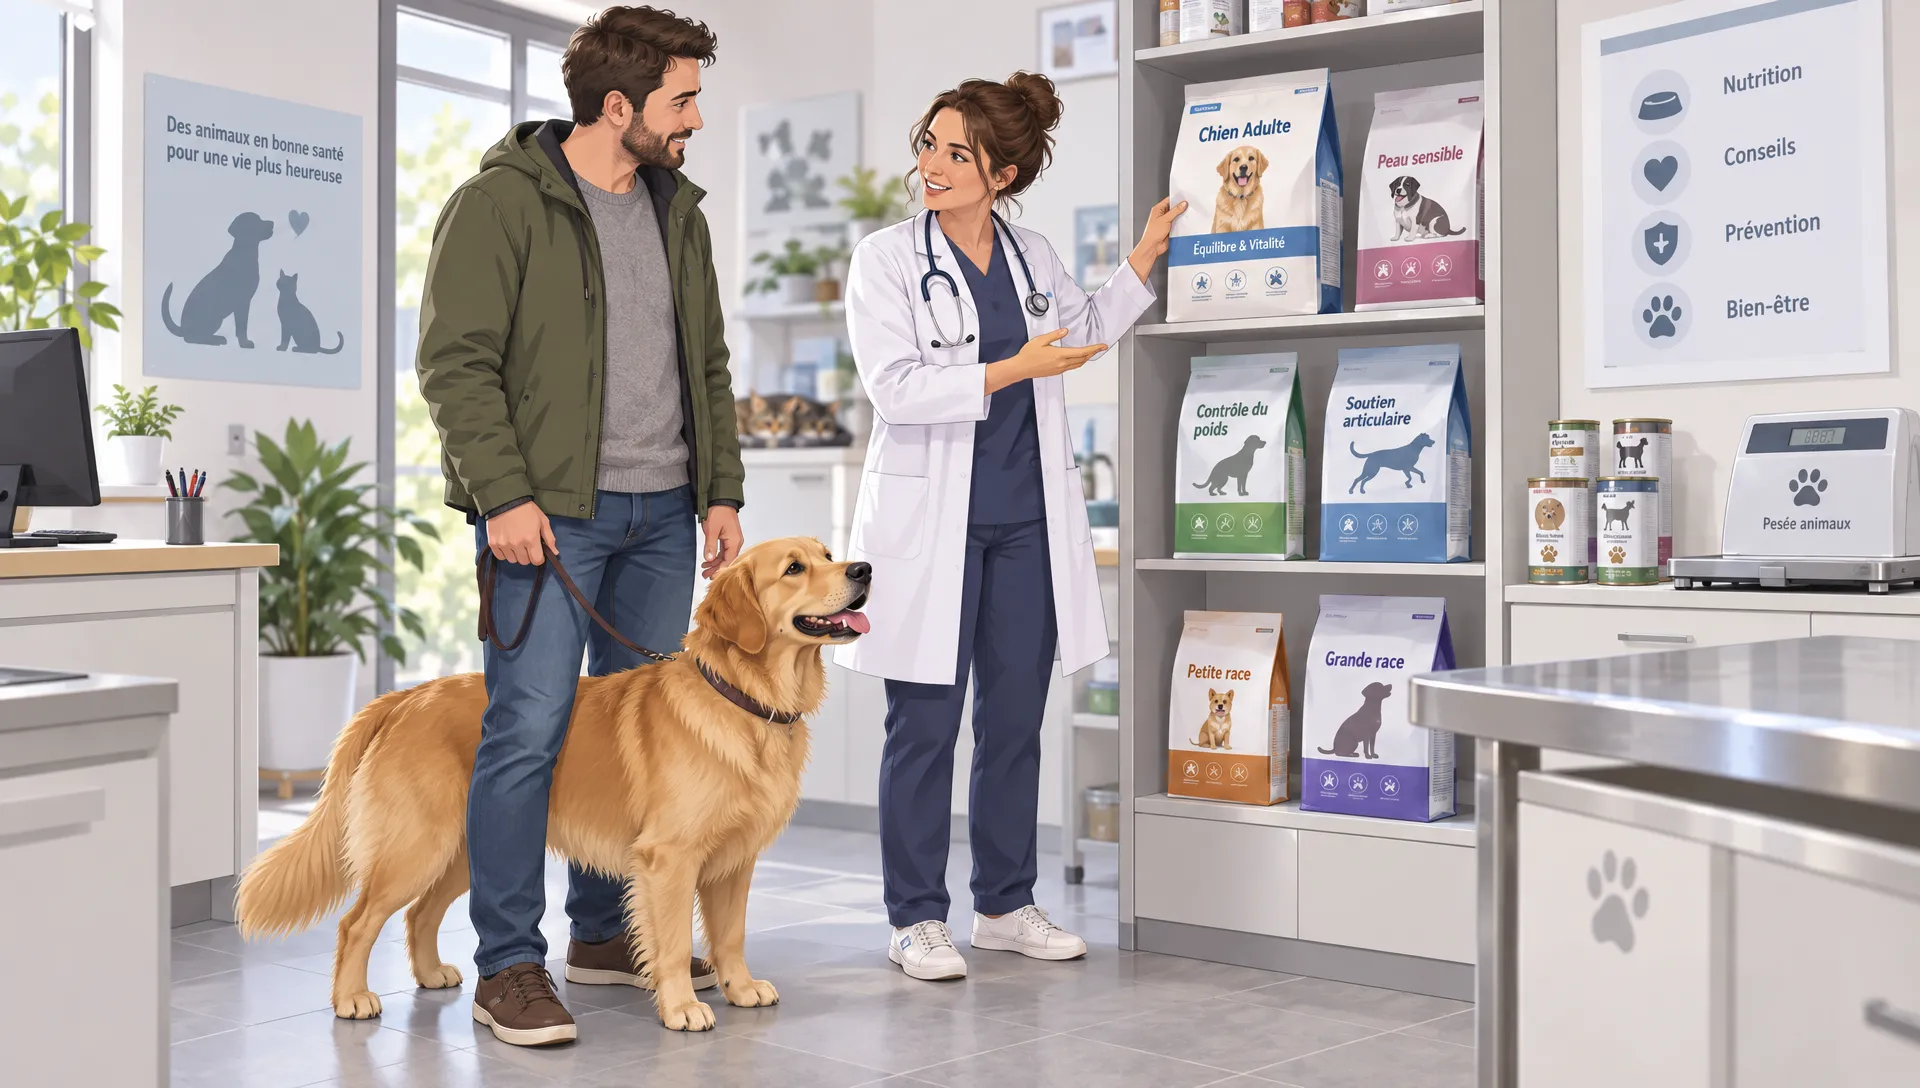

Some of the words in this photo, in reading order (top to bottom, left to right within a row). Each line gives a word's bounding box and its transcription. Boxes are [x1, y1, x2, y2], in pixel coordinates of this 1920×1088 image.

[1723, 65, 1802, 95] Nutrition
[166, 115, 193, 136] Des
[195, 122, 250, 146] animaux
[253, 135, 269, 149] en
[272, 134, 310, 156] bonne
[312, 146, 345, 162] santé
[1198, 124, 1239, 143] Chien
[1242, 118, 1292, 137] Adulte
[1377, 154, 1409, 169] Peau
[1411, 145, 1464, 165] sensible
[1724, 137, 1796, 167] Conseils
[166, 145, 200, 163] pour
[203, 152, 229, 167] une
[232, 153, 252, 170] vie
[255, 156, 282, 176] plus
[285, 160, 343, 184] heureuse
[1725, 214, 1822, 243] Prévention
[1193, 240, 1237, 258] Équilibre
[1238, 239, 1247, 252] &
[1249, 236, 1286, 250] Vitalité
[1727, 294, 1810, 319] Bien-être
[1196, 402, 1249, 419] Contrôle
[1251, 401, 1269, 416] du
[1345, 395, 1397, 411] Soutien
[1193, 421, 1229, 441] poids
[1342, 411, 1412, 428] articulaire
[1763, 516, 1797, 530] Pesée
[1800, 516, 1851, 530] animaux
[1187, 663, 1223, 680] Petite
[1225, 669, 1252, 681] race
[1325, 651, 1373, 668] Grande
[1375, 656, 1405, 670] race
